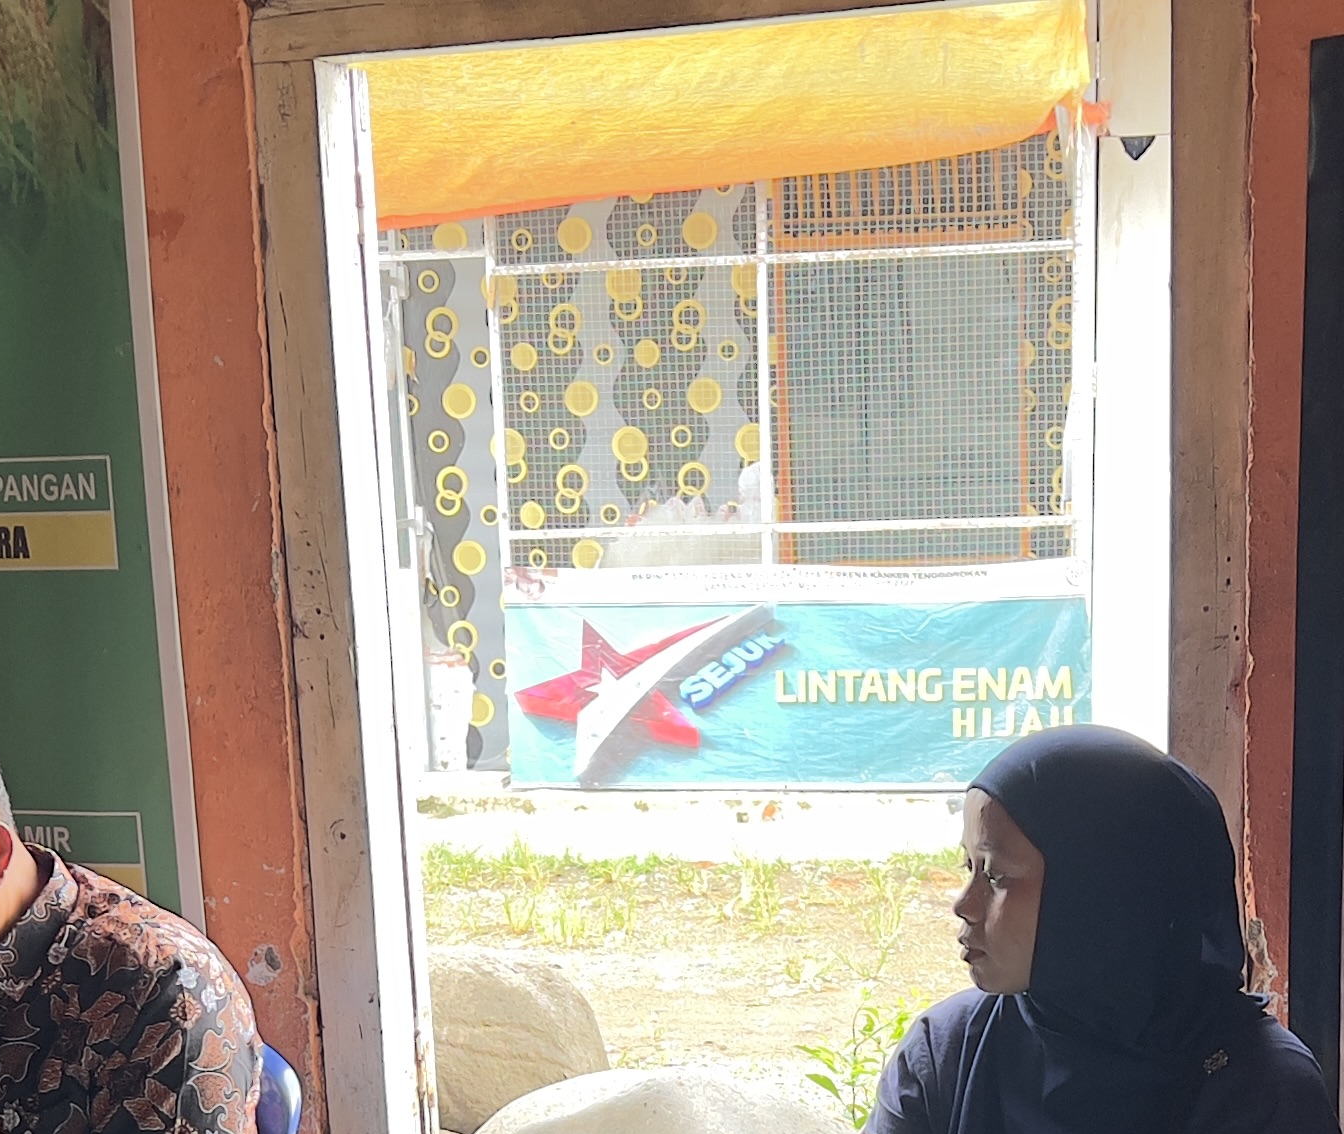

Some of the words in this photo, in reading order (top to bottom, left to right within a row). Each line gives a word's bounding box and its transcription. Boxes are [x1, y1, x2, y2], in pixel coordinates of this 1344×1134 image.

[775, 667, 943, 704] LINTANG
[951, 665, 1074, 702] ENAM
[23, 825, 72, 853] MIR
